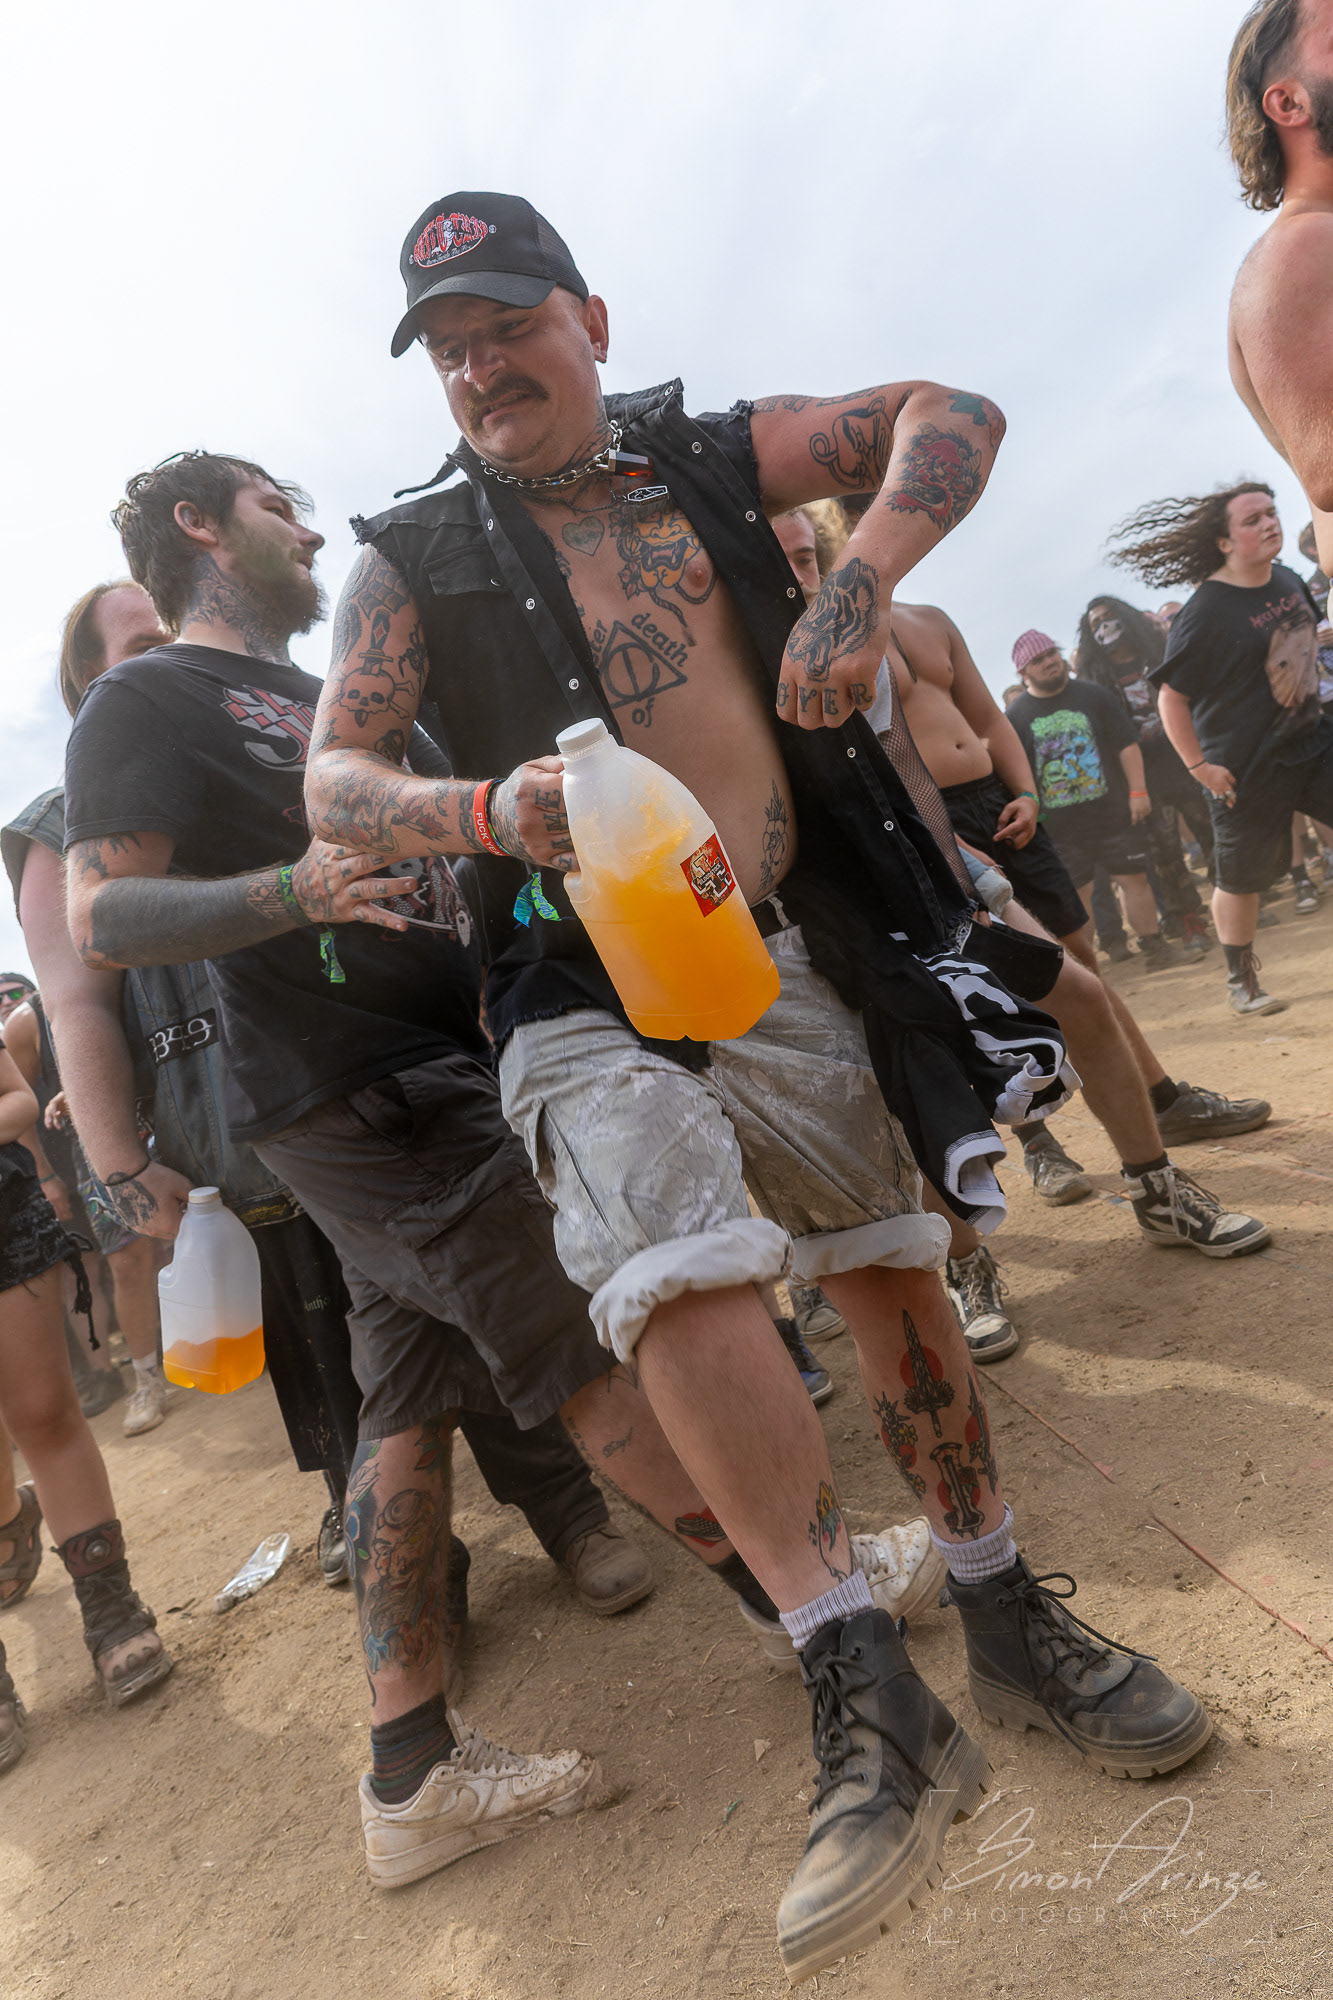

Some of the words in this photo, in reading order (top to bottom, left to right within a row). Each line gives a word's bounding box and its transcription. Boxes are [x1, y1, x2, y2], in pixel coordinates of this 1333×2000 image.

[630, 612, 689, 667] death
[631, 697, 656, 728] of
[777, 682, 873, 716] OVER
[476, 812, 489, 840] FUCK
